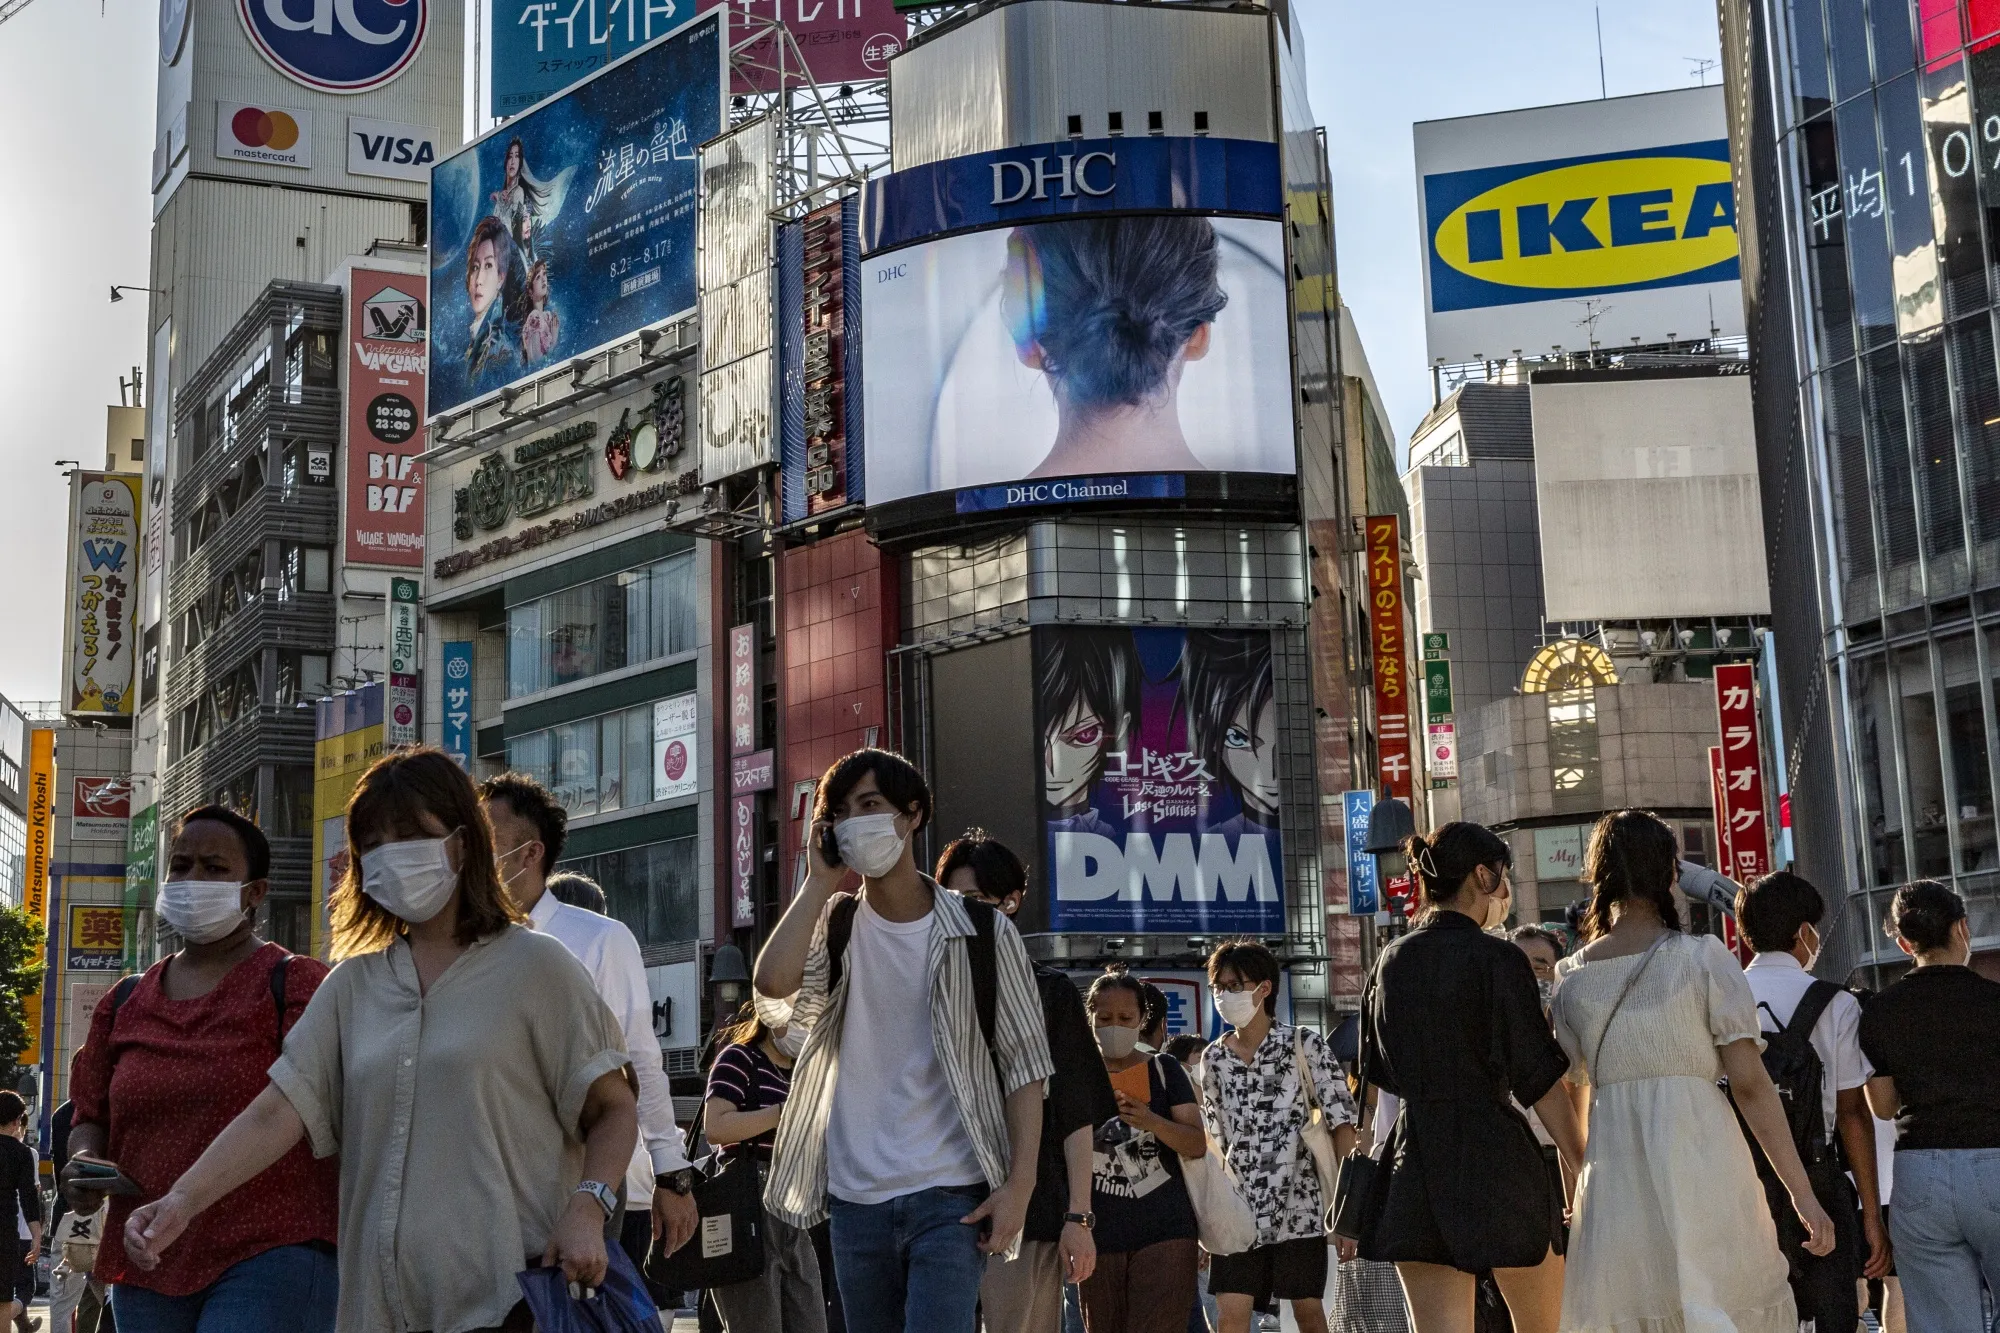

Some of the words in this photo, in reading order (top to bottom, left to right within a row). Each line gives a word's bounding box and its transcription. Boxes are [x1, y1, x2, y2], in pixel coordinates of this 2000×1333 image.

[812, 32, 838, 43] ピーチ
[537, 56, 598, 73] スティック
[865, 43, 898, 62] 生薬
[234, 149, 296, 163] mastercard
[353, 131, 435, 165] VISA
[989, 152, 1116, 206] DHC
[1465, 181, 1738, 263] IKEA
[877, 263, 907, 284] DHC
[802, 214, 834, 497] 三千里薬品
[1718, 362, 1750, 375] デザイン
[368, 453, 415, 480] B1F
[367, 485, 417, 513] B2F
[1006, 485, 1048, 505] DHC
[1051, 480, 1128, 502] Channel
[91, 517, 123, 525] マツキヨ
[356, 530, 384, 546] VILLAGE
[1371, 524, 1400, 699] クスリのことなら
[391, 697, 415, 705] クリニック
[735, 634, 752, 747] お好み焼
[656, 707, 695, 726] レーザー脱毛
[1103, 747, 1216, 783] コードギアス
[1379, 713, 1410, 808] 三千
[1722, 686, 1762, 832] カラオケ
[34, 772, 47, 827] KiYoshi
[674, 780, 697, 793] クリニック
[1138, 780, 1213, 798] 反逆のルルーシュ
[1122, 793, 1153, 820] Lost
[1153, 799, 1197, 824] Stories
[76, 821, 112, 829] Matsumoto
[90, 828, 119, 836] Holdings
[736, 801, 752, 920] もんじゃ焼
[1054, 831, 1279, 902] DMM
[81, 910, 122, 947] 薬
[1095, 1175, 1134, 1199] Think
